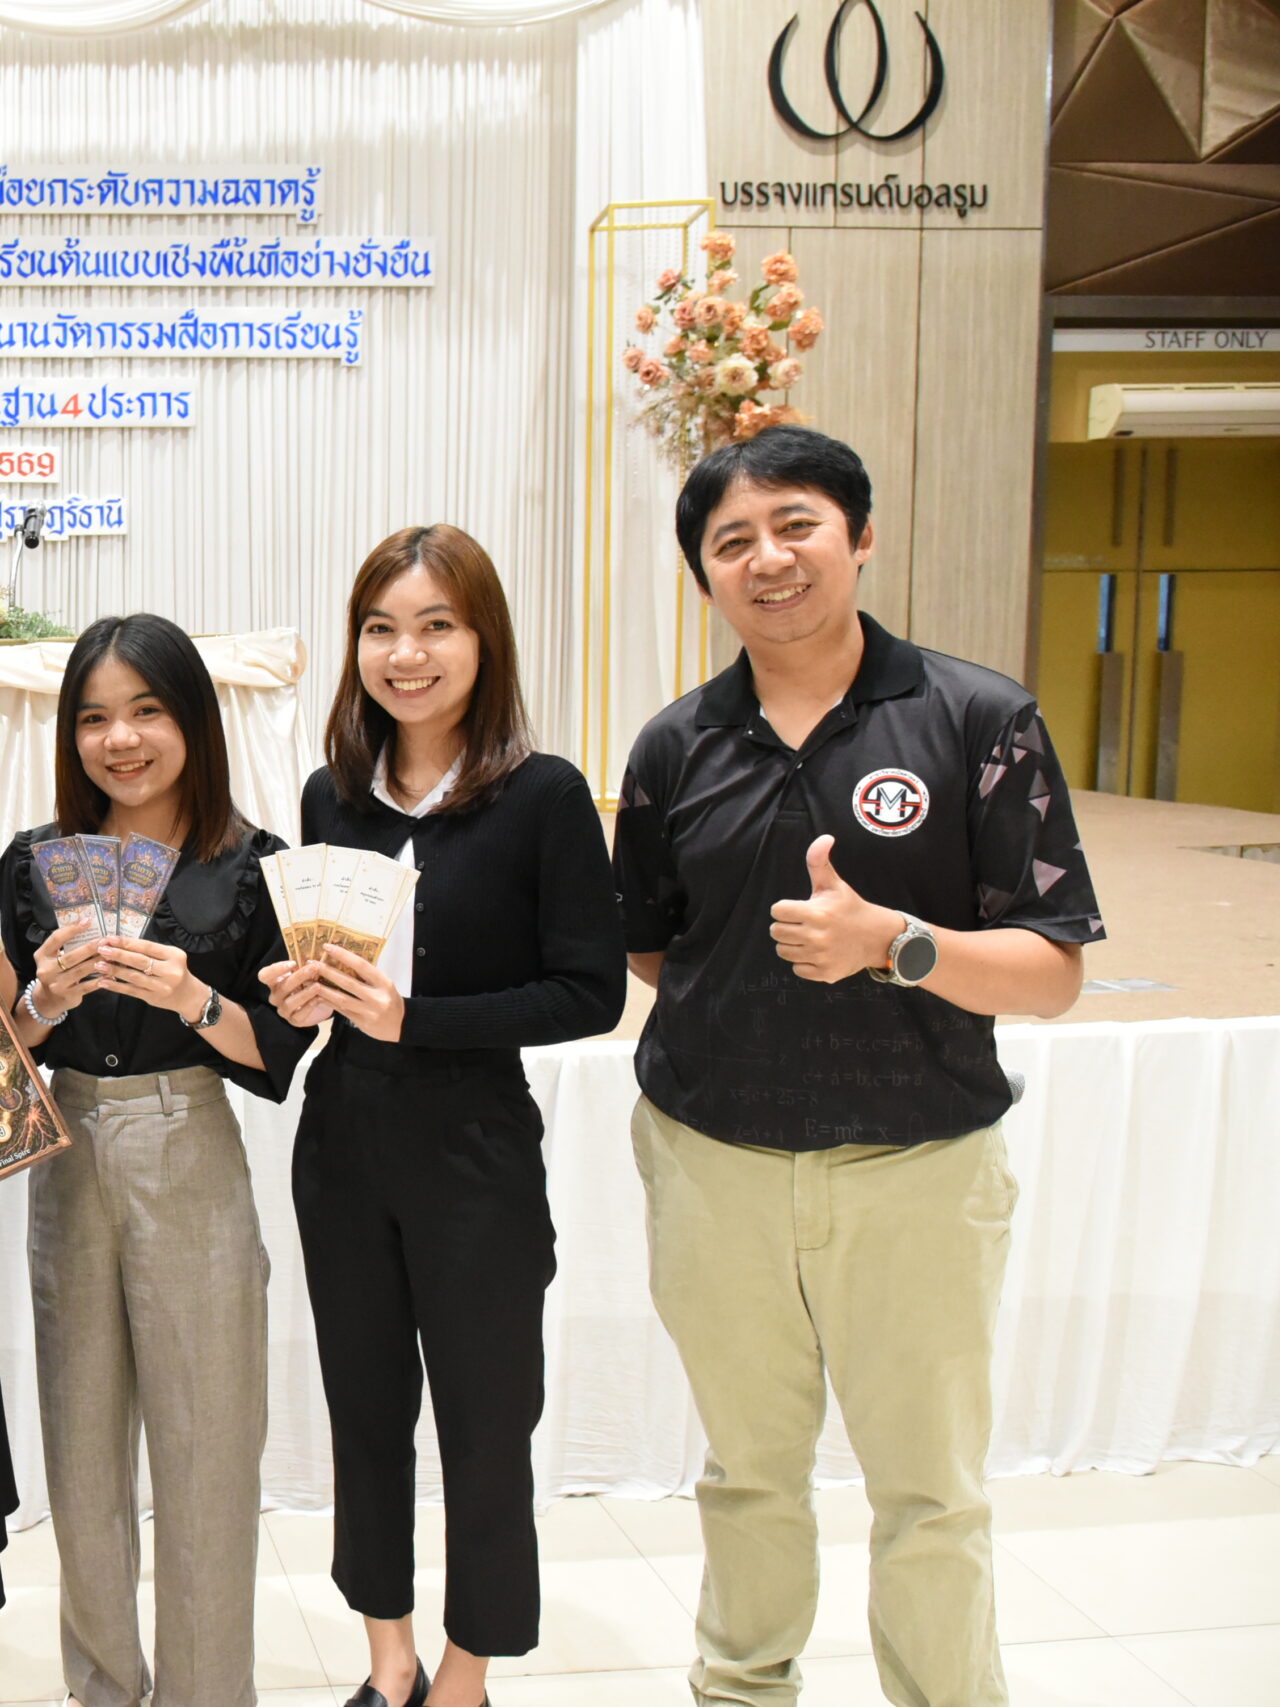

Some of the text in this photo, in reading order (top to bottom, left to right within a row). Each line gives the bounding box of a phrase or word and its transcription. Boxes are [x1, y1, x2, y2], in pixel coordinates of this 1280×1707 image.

[719, 173, 989, 219] บรรจงแกรนด์บอลรูม
[1145, 331, 1270, 349] STAFF ONLY
[14, 1148, 32, 1162] Spire
